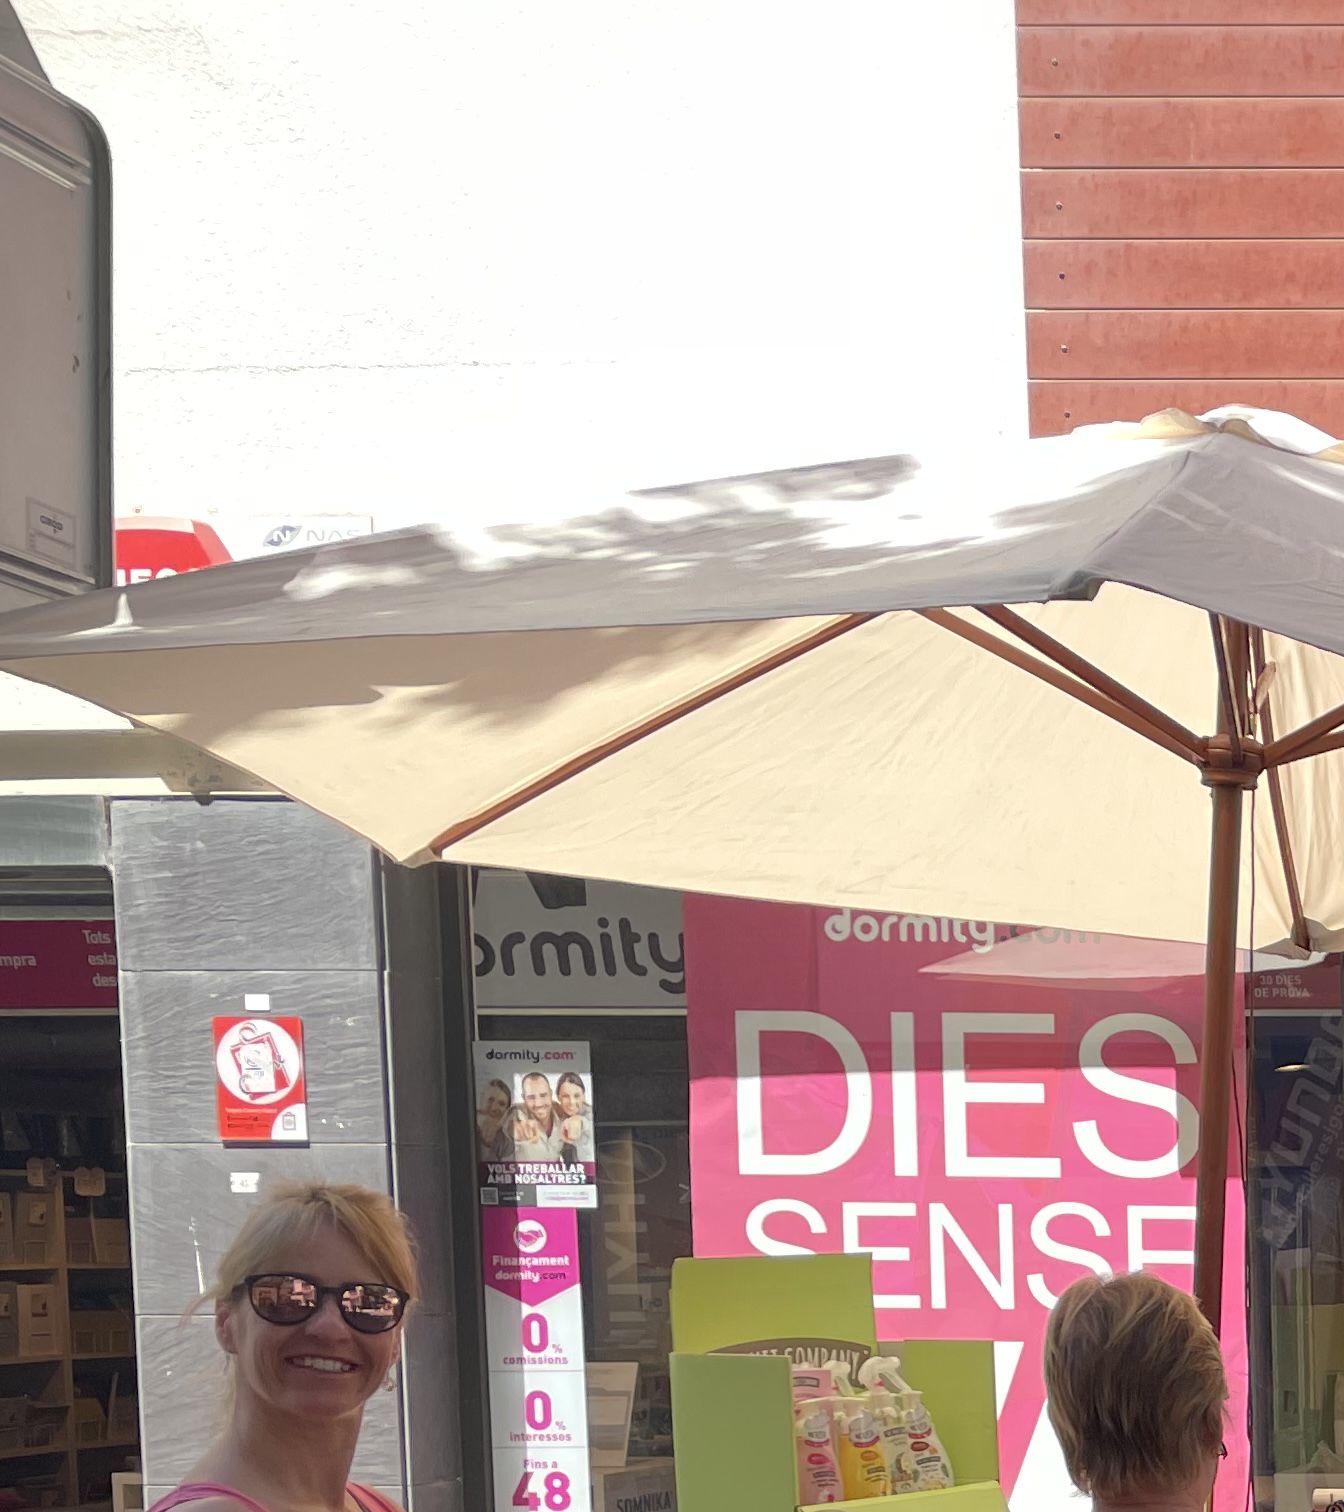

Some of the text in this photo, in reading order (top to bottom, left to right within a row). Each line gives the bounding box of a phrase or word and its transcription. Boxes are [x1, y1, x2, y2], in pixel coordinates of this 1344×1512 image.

[82, 930, 111, 945] Tots
[486, 1049, 574, 1063] dormity.com
[734, 1010, 1200, 1179] DIES
[487, 1164, 585, 1174] VOLS TREBALLAR
[487, 1174, 587, 1184] AMB NOSALTRES?
[492, 1255, 570, 1268] Finançament
[495, 1270, 566, 1283] dormity.com
[503, 1355, 569, 1365] comissions
[509, 1431, 573, 1442] interessos
[523, 1459, 558, 1469] Fins a
[512, 1471, 572, 1512] 48
